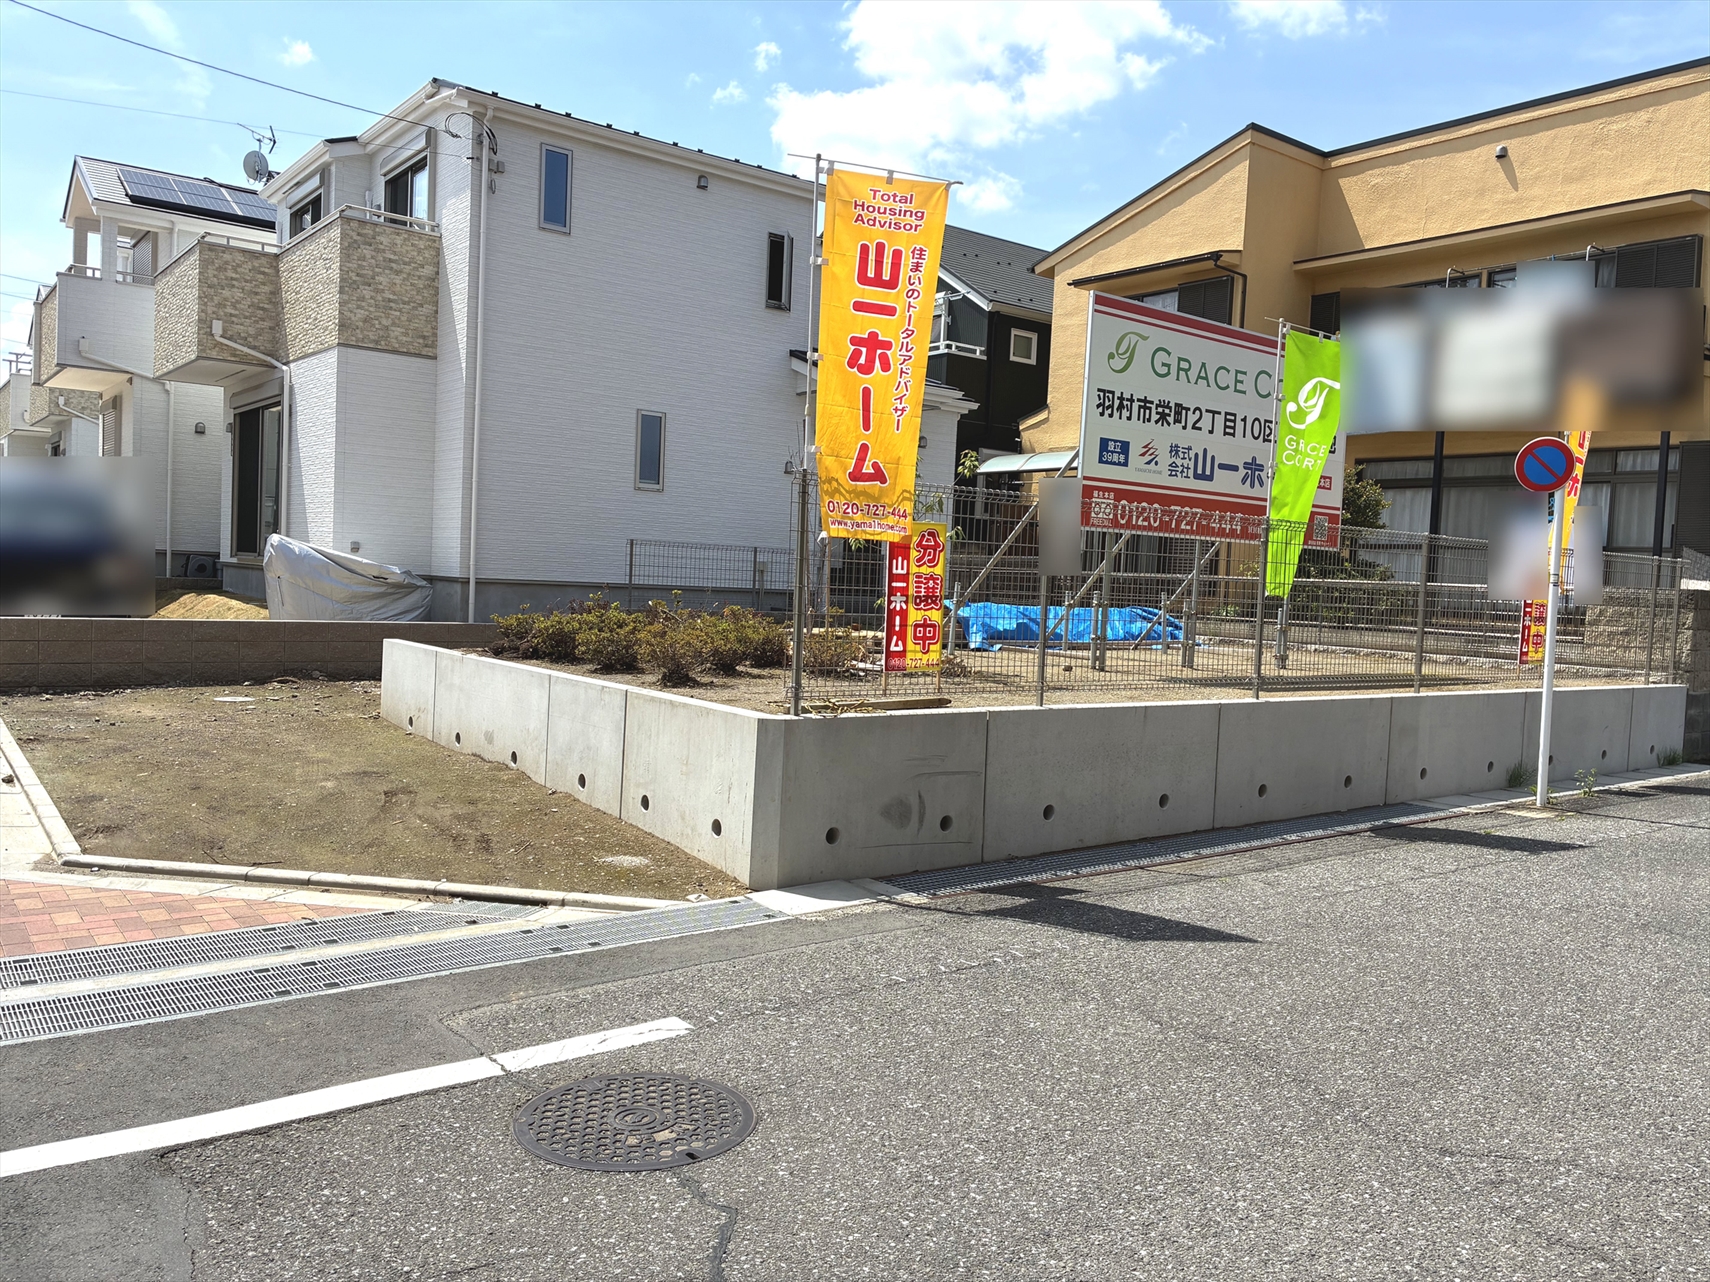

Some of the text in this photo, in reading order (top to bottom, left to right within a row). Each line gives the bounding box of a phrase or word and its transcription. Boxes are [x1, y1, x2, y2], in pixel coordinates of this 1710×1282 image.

[869, 188, 914, 205] Total
[853, 199, 925, 222] Housing
[853, 213, 923, 233] Advisor
[892, 245, 928, 432] 住まいのトータルアドバイザー
[846, 240, 904, 486] 山一ホーム
[1150, 346, 1283, 402] GRACE C
[1107, 440, 1121, 452] 設立
[1169, 443, 1193, 461] 株式
[1101, 451, 1126, 464] 39周年
[1193, 447, 1275, 490] 山一ホ
[1167, 461, 1191, 479] 会社
[827, 499, 908, 521] 0120-727-444
[1117, 499, 1242, 535] 0120-727-444
[829, 518, 908, 534] www.yama1home.com
[911, 528, 945, 655] 分譲中
[890, 555, 908, 652] 山一ホーム
[887, 657, 940, 670] 0120-727-444
